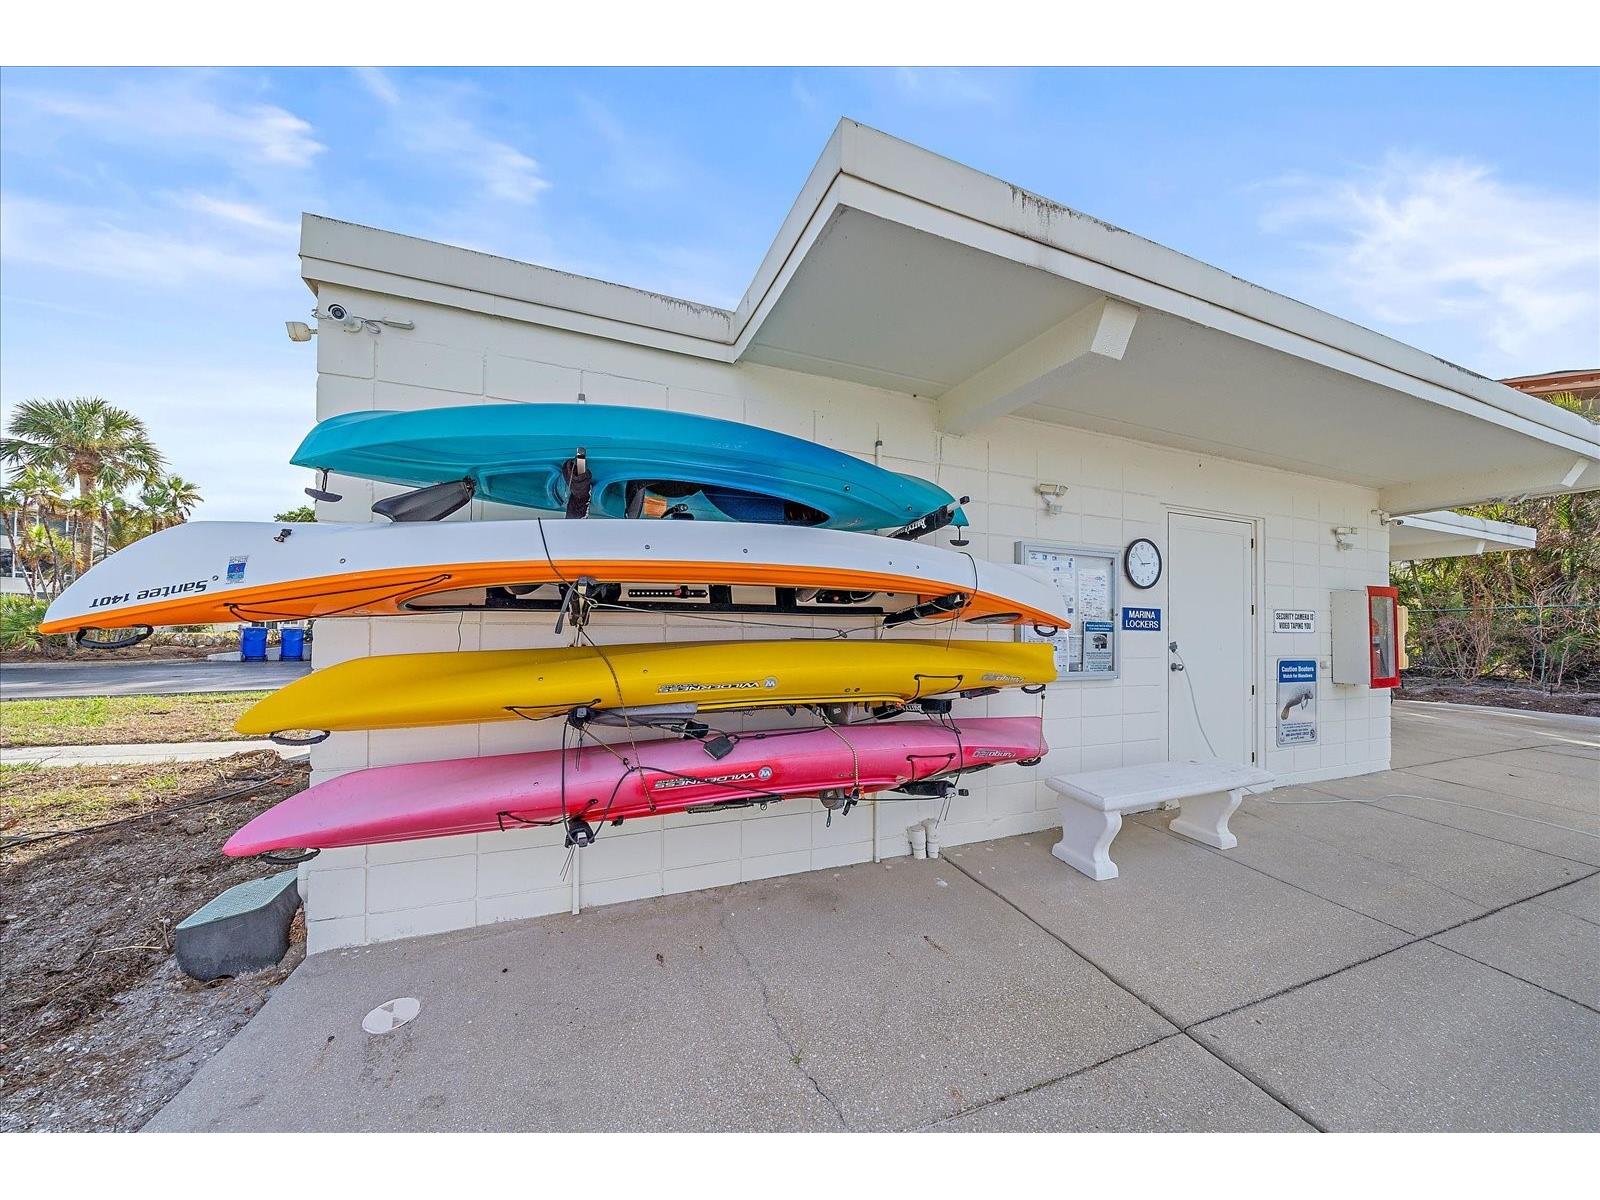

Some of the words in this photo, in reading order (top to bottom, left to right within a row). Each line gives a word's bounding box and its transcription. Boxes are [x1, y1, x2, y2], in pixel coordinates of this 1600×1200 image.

[136, 579, 208, 600] Santee
[88, 592, 129, 609] 140T
[1128, 610, 1156, 619] MARINA
[1276, 612, 1294, 620] SECURITY
[1125, 619, 1159, 629] LOCKERS
[658, 680, 760, 693] WILDERNESS
